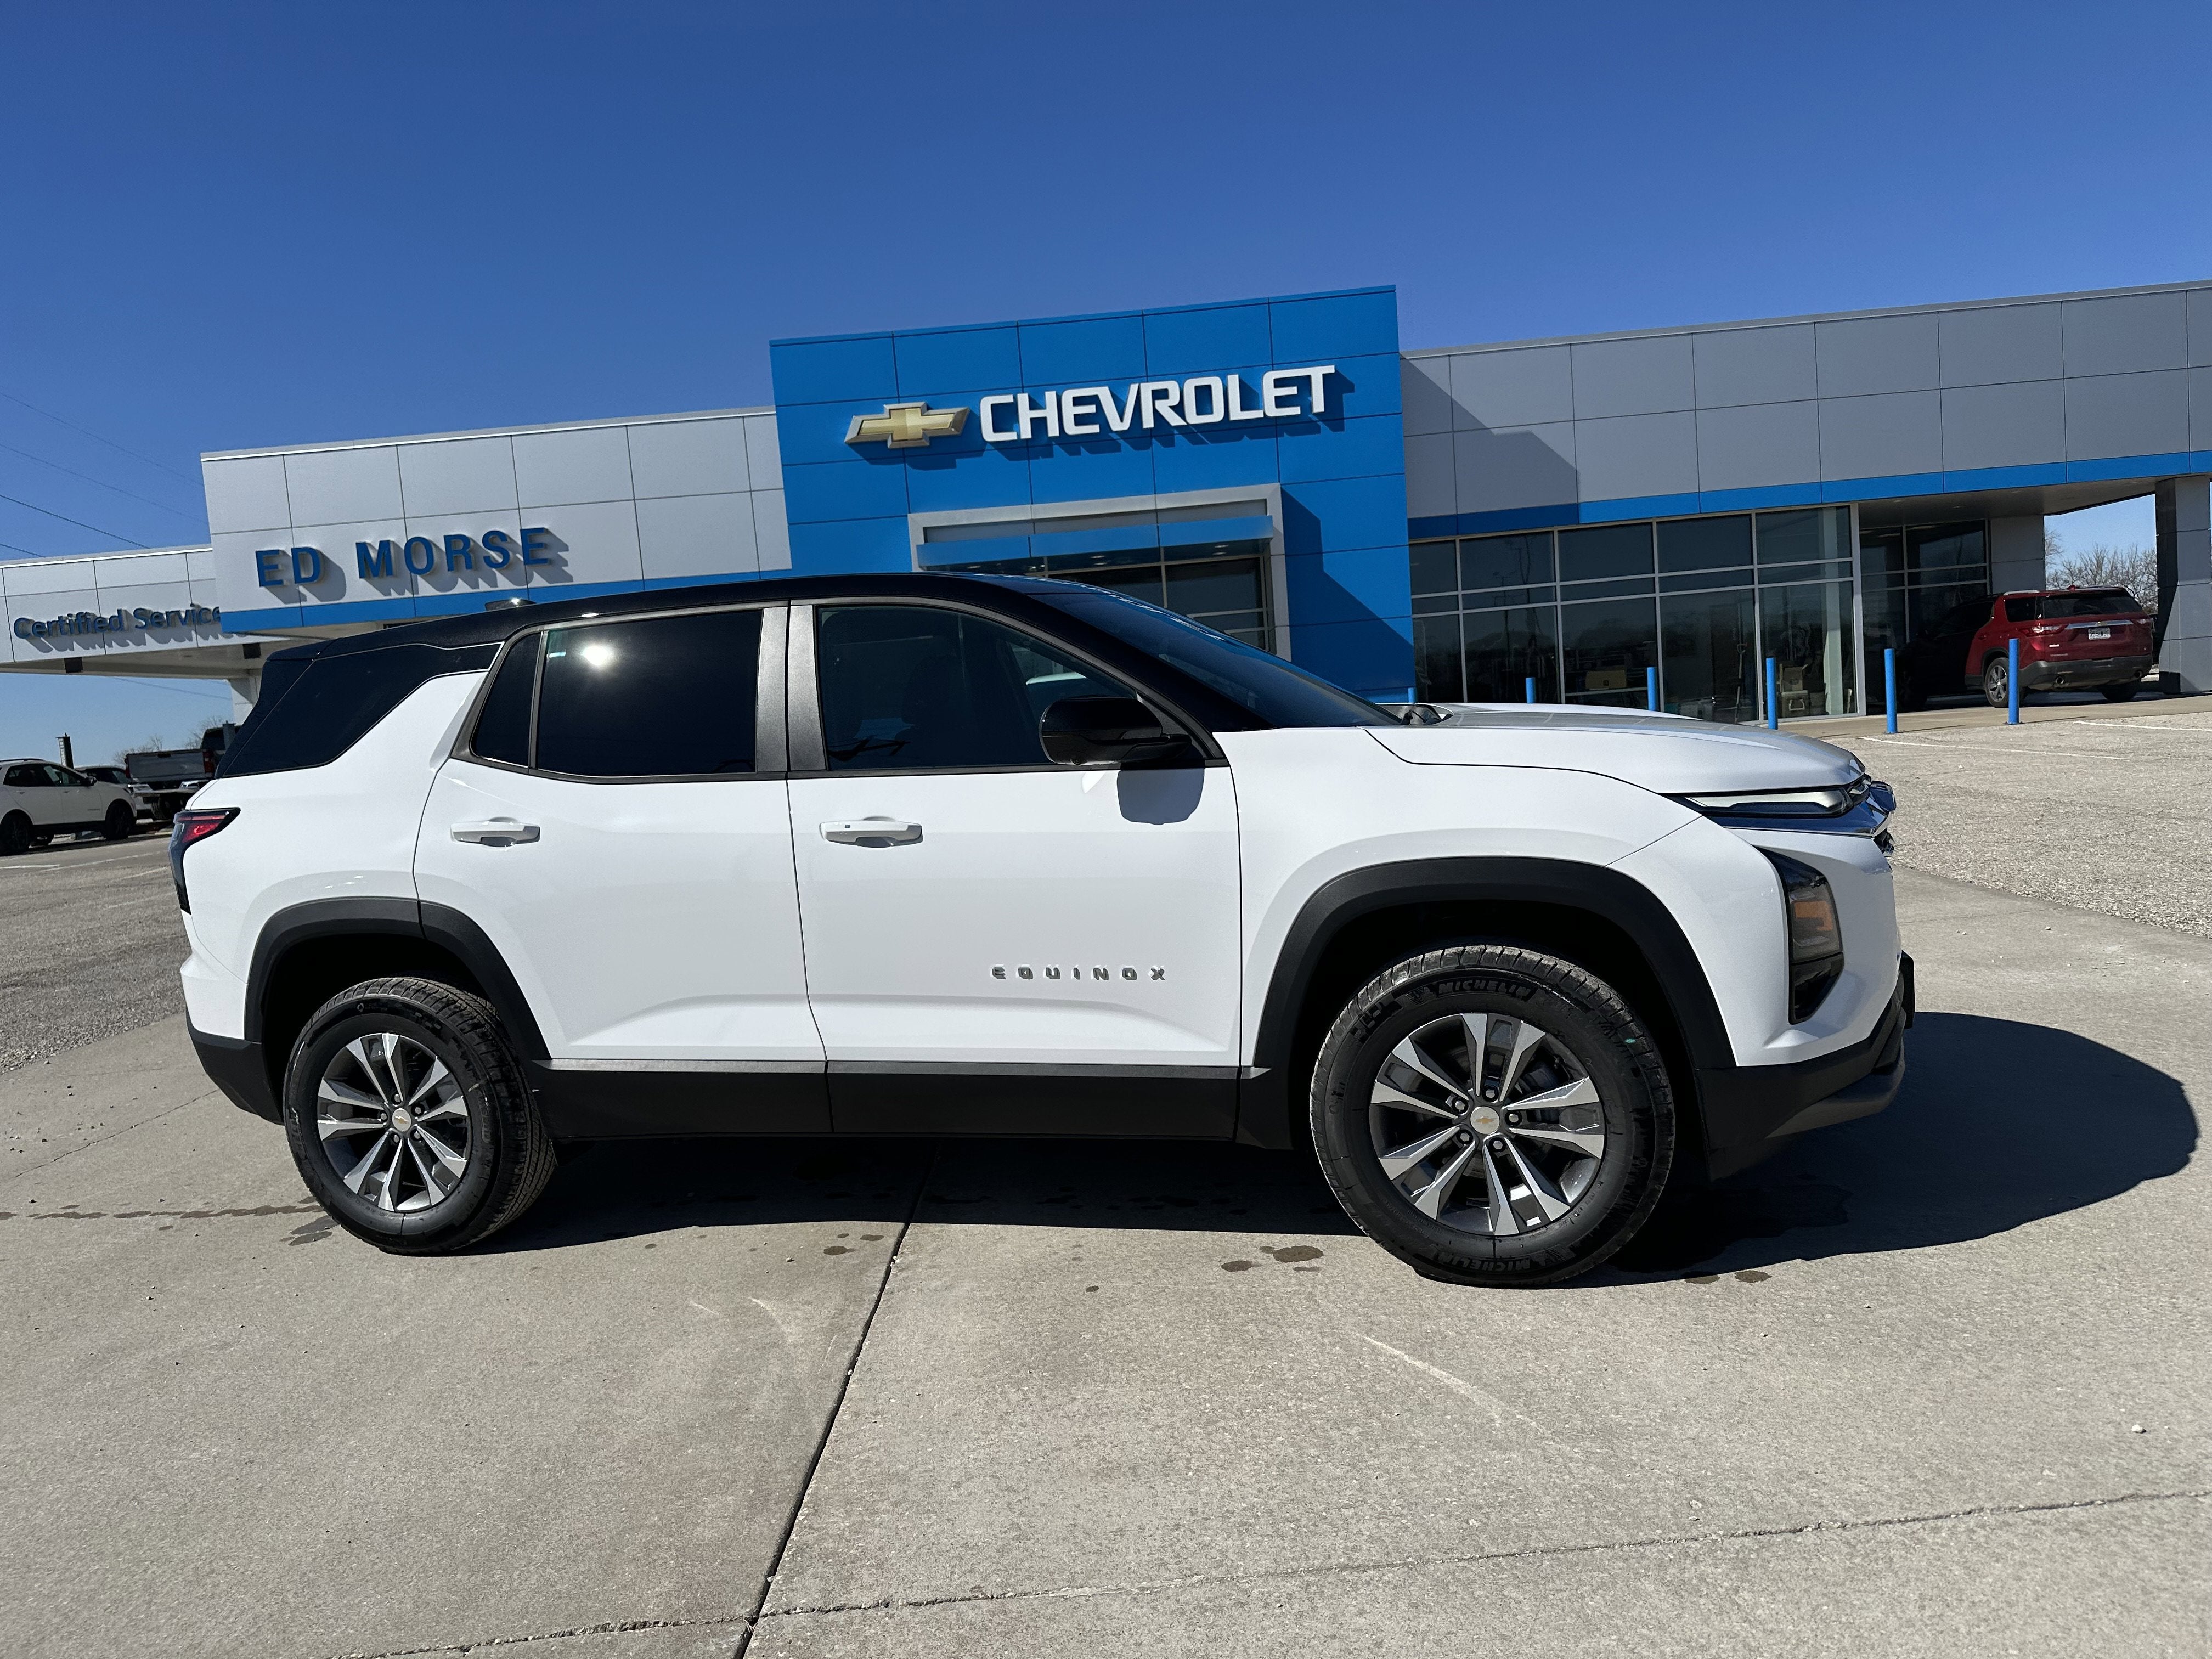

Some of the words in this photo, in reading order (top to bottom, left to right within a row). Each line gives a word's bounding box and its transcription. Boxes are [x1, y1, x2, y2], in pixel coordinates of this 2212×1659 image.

[980, 365, 1335, 442] CHEVROLET
[256, 546, 321, 588] ED
[356, 527, 550, 579] MORSE
[14, 608, 125, 639] Certified
[991, 966, 1166, 981] EQUINOX
[1438, 979, 1532, 999] MICHELIN
